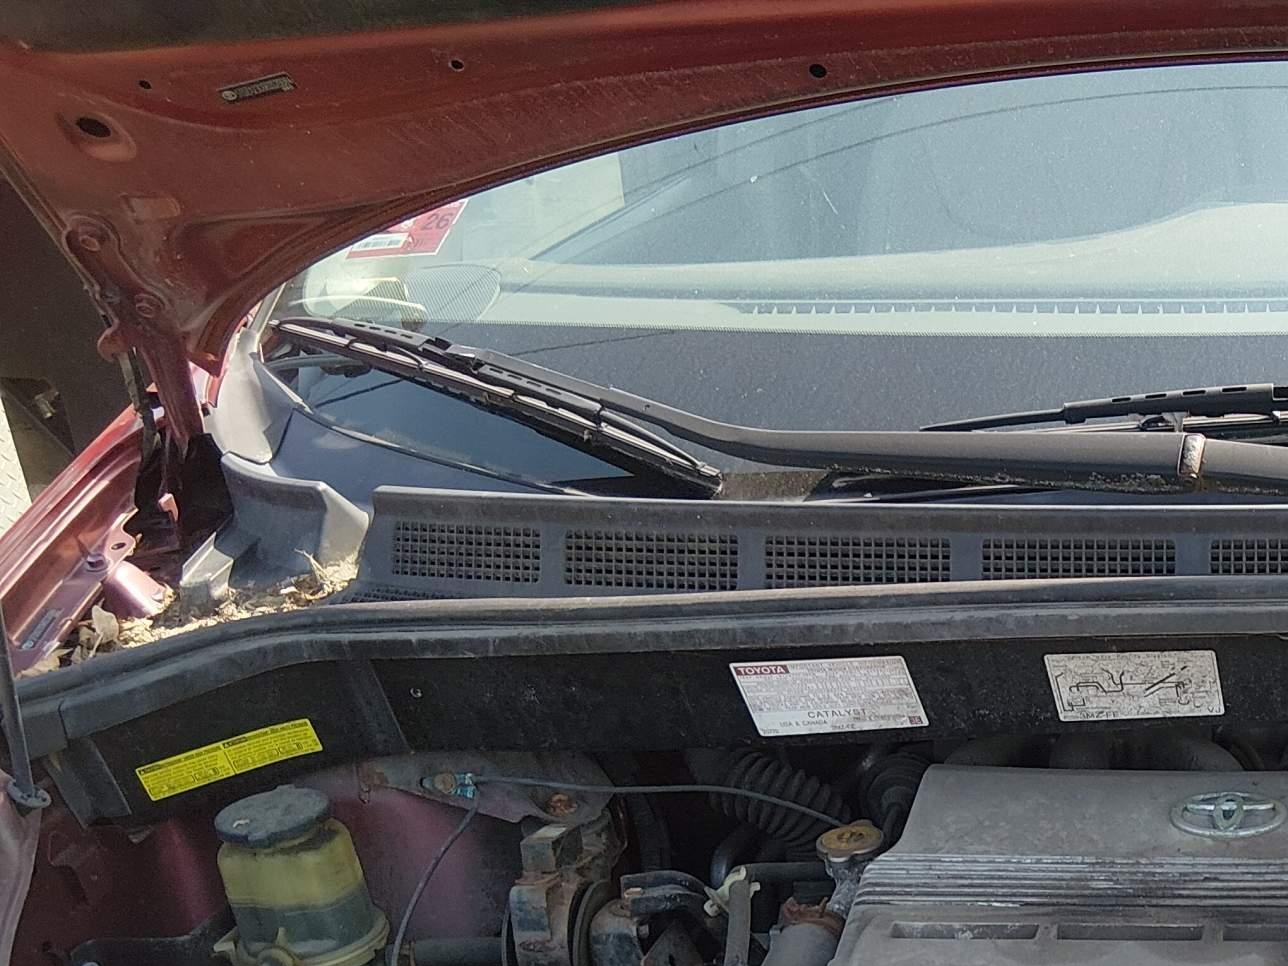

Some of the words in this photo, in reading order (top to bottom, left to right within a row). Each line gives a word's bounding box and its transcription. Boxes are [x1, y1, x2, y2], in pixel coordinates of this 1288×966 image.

[421, 212, 454, 230] 26
[737, 665, 786, 675] TOYOTA
[807, 708, 867, 719] CATALYST
